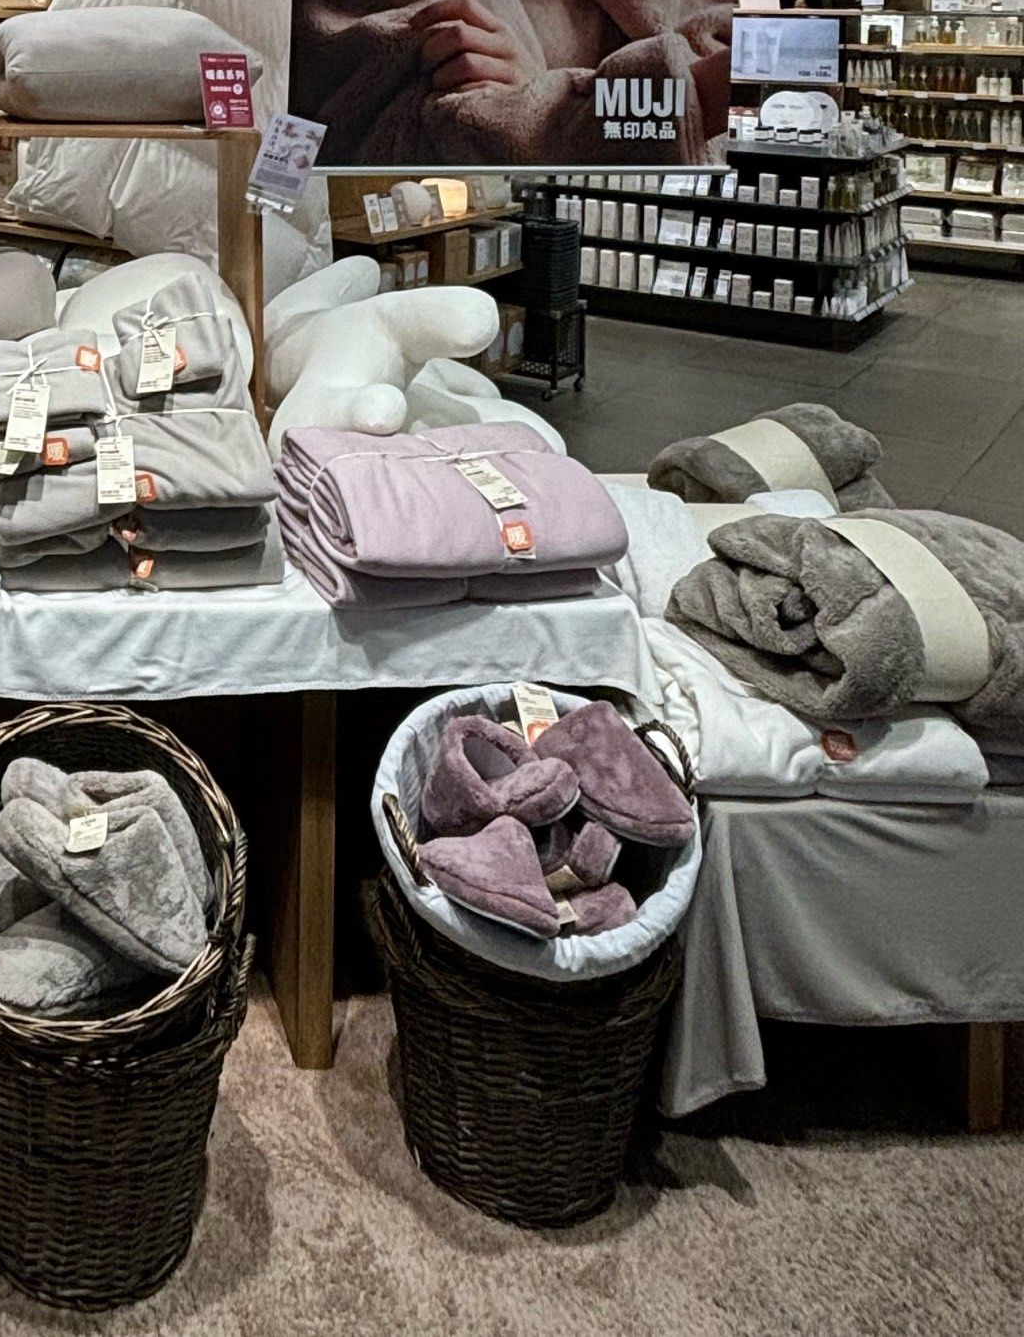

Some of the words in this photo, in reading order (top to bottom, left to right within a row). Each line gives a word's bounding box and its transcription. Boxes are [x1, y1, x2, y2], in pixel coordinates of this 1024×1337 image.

[595, 77, 686, 118] MUJI
[603, 120, 677, 140] 無印良品
